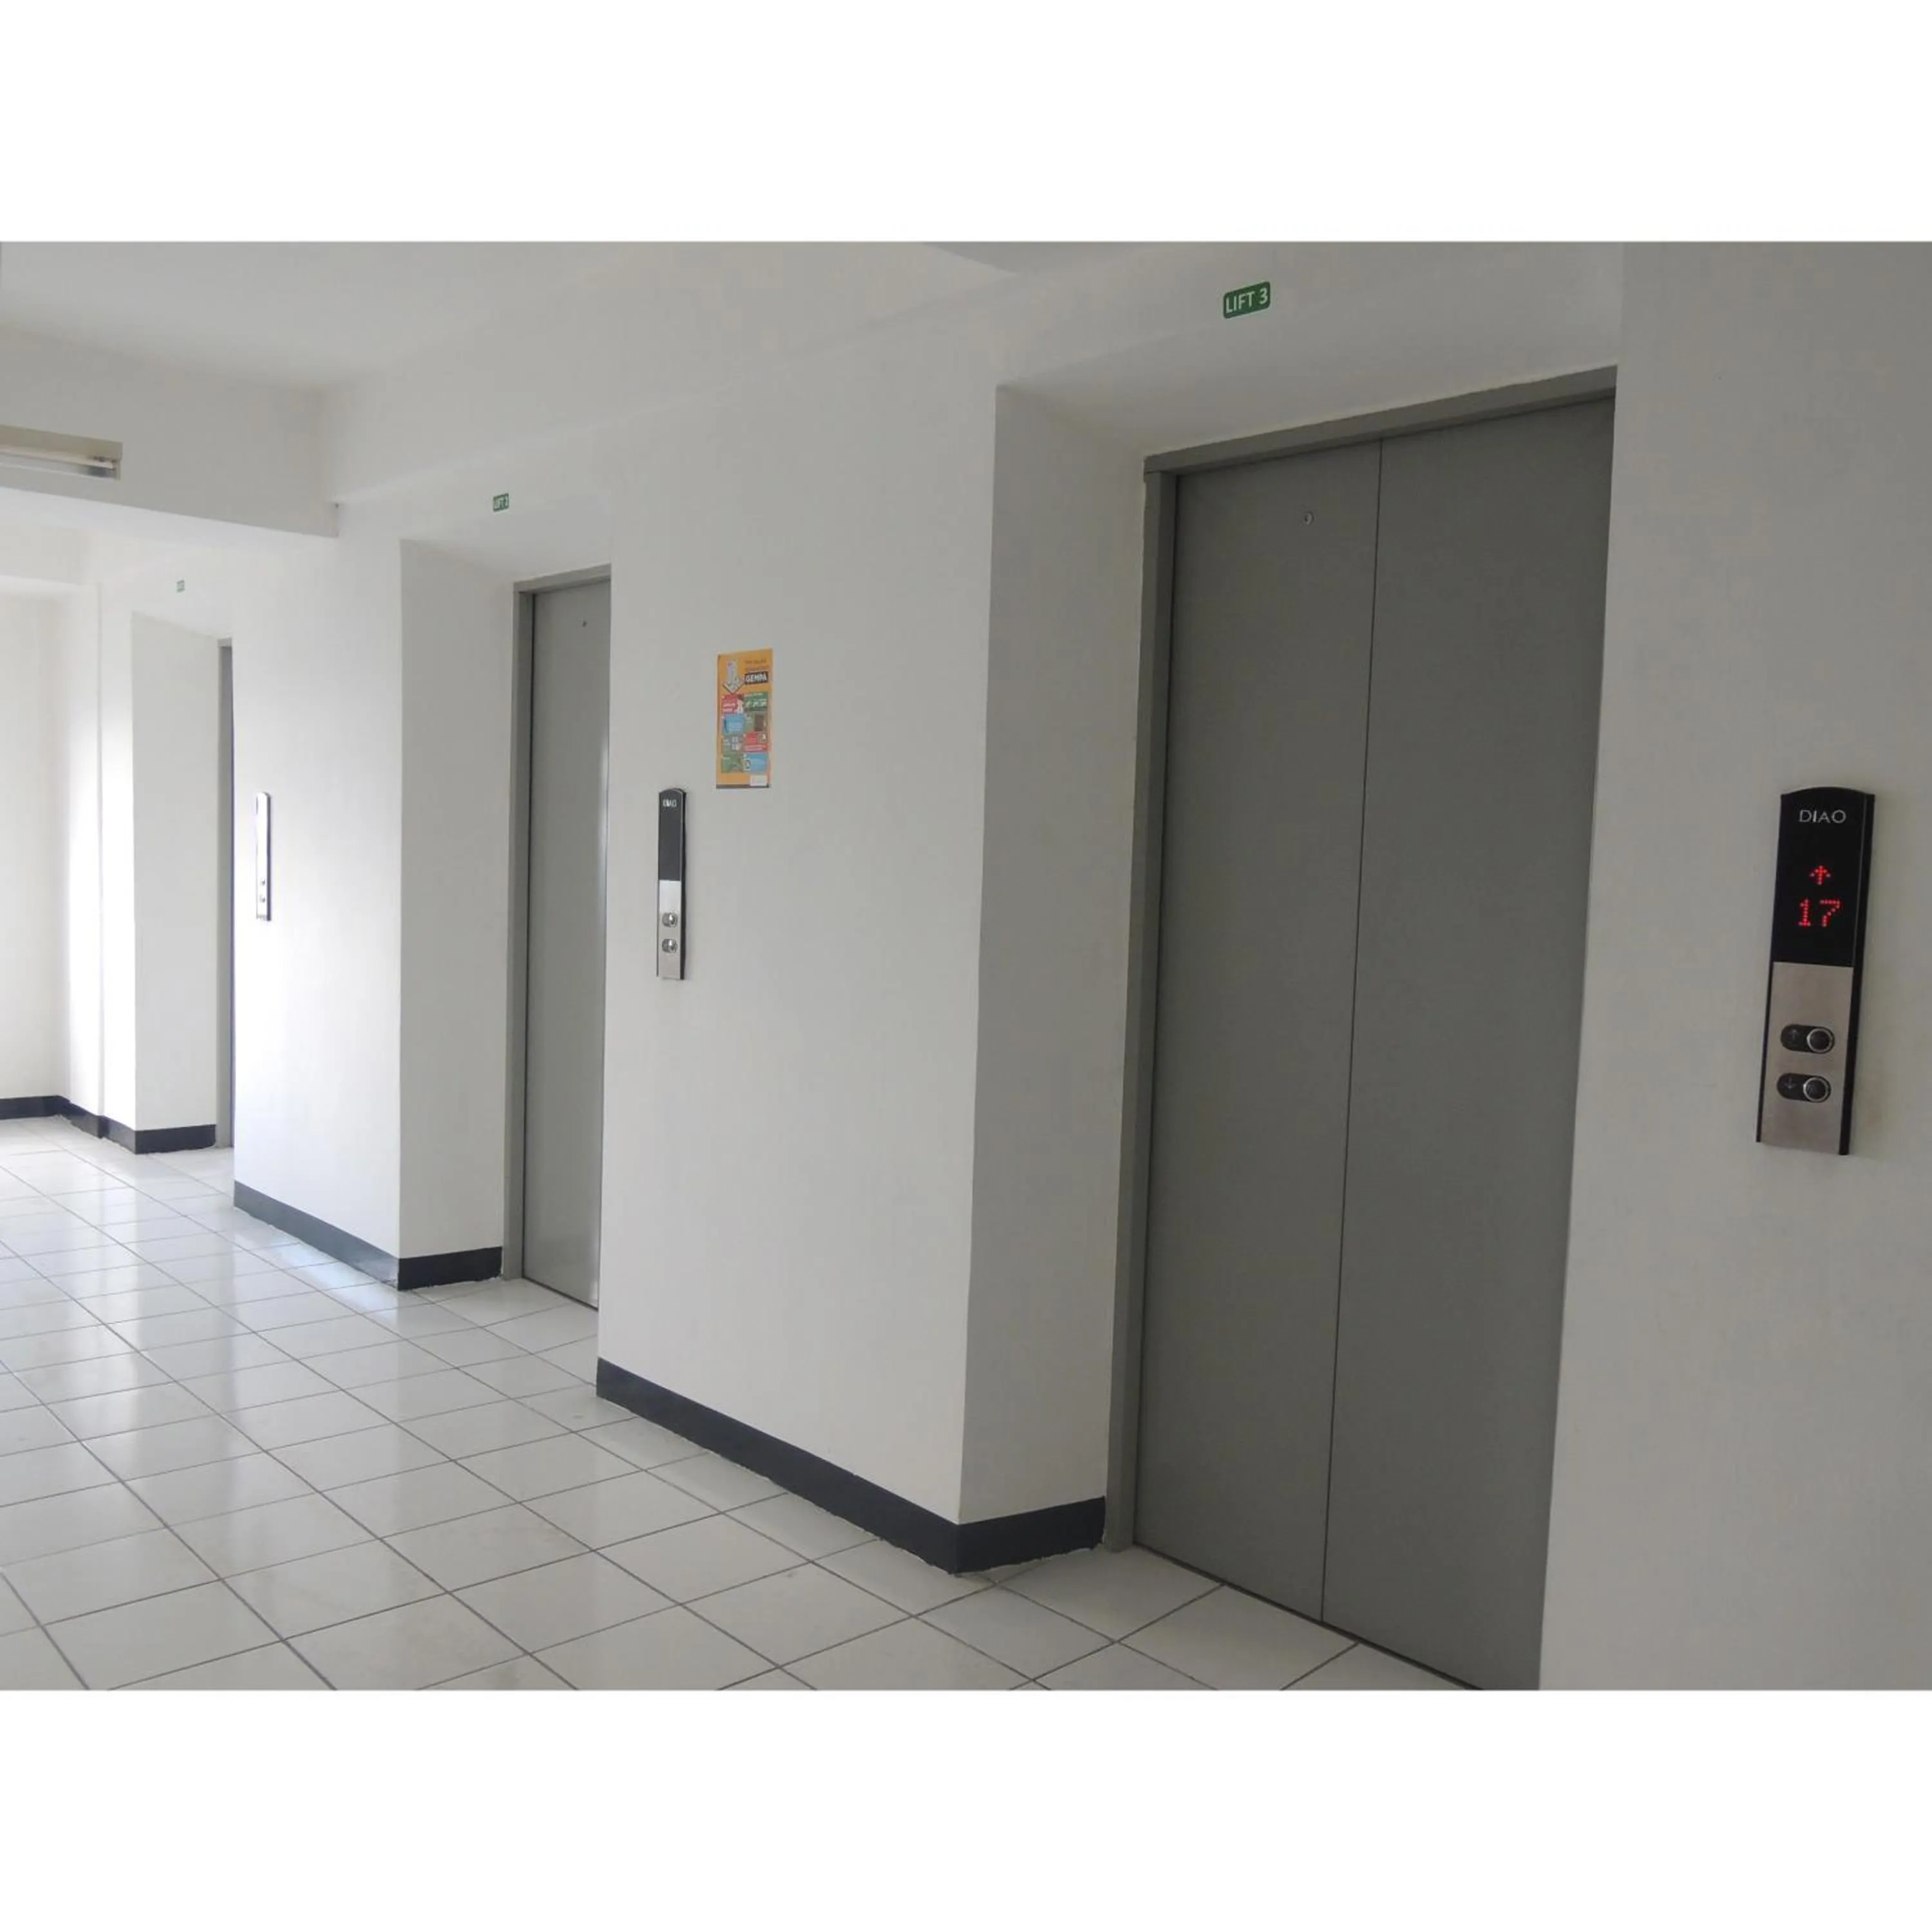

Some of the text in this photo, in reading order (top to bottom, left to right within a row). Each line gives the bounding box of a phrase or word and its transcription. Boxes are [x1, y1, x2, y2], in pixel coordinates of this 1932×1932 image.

[1226, 287, 1268, 314] LIFT 3
[745, 672, 767, 683] GEMPA
[1799, 810, 1847, 824] DIAO
[1798, 898, 1841, 927] 17
